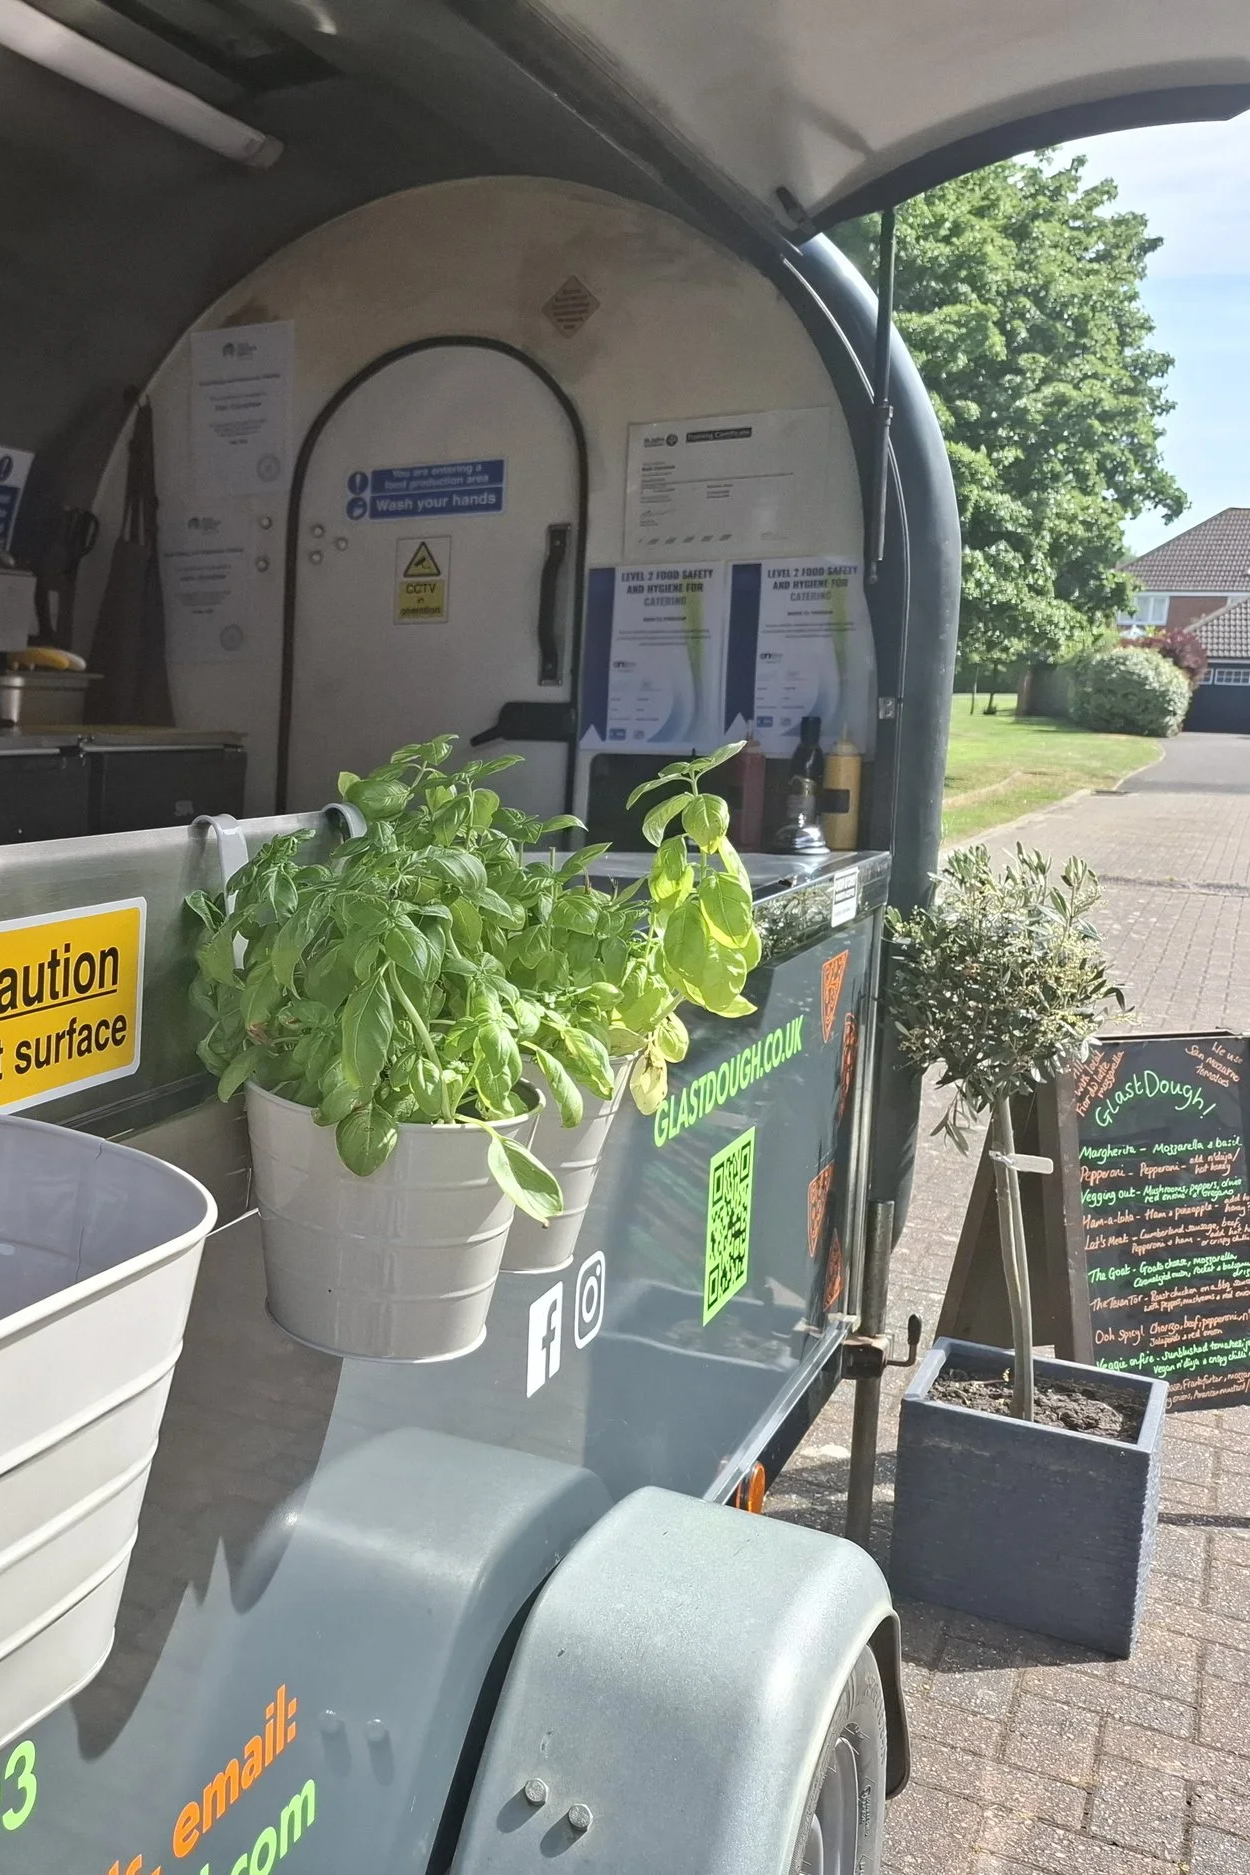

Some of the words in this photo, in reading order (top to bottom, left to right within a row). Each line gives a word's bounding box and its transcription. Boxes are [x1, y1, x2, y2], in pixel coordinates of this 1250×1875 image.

[392, 469, 410, 478] You
[376, 499, 413, 512] Wash
[417, 497, 448, 511] your
[452, 492, 496, 506] hands
[621, 571, 644, 582] LEVEL
[647, 571, 653, 581] 2
[656, 570, 679, 580] FOOD
[682, 569, 713, 580] SAFETY
[767, 568, 792, 579] LEVEL
[794, 568, 800, 578] 2
[801, 567, 824, 577] FOOD
[827, 565, 858, 576] SAFETY
[405, 583, 437, 594] CCTV
[626, 583, 644, 594] AND
[647, 583, 684, 594] HYGIENE
[686, 582, 704, 593] FOR
[773, 580, 791, 590] AND
[793, 579, 830, 590] HYGIENE
[831, 578, 849, 588] FOR
[643, 596, 687, 607] CATERING
[790, 591, 832, 602] CATERING
[14, 1014, 127, 1075] surface
[1212, 1041, 1226, 1056] We
[1185, 1045, 1204, 1060] San
[654, 1014, 804, 1147] GLASTDOUGH.CO.UK
[1079, 1144, 1136, 1164] Margherita
[1153, 1139, 1204, 1155] Mozzarella
[1215, 1134, 1242, 1148] basil
[1080, 1164, 1125, 1186] Pepperoni
[1140, 1161, 1180, 1179] Pepperoni
[1081, 1189, 1116, 1208] Vegging
[1118, 1186, 1136, 1198] out
[1144, 1208, 1166, 1220] Ham
[1088, 1268, 1107, 1283] The
[1108, 1263, 1131, 1280] Goat
[1089, 1298, 1108, 1311] The
[1095, 1327, 1115, 1344] Ooh
[172, 1683, 298, 1858] email:
